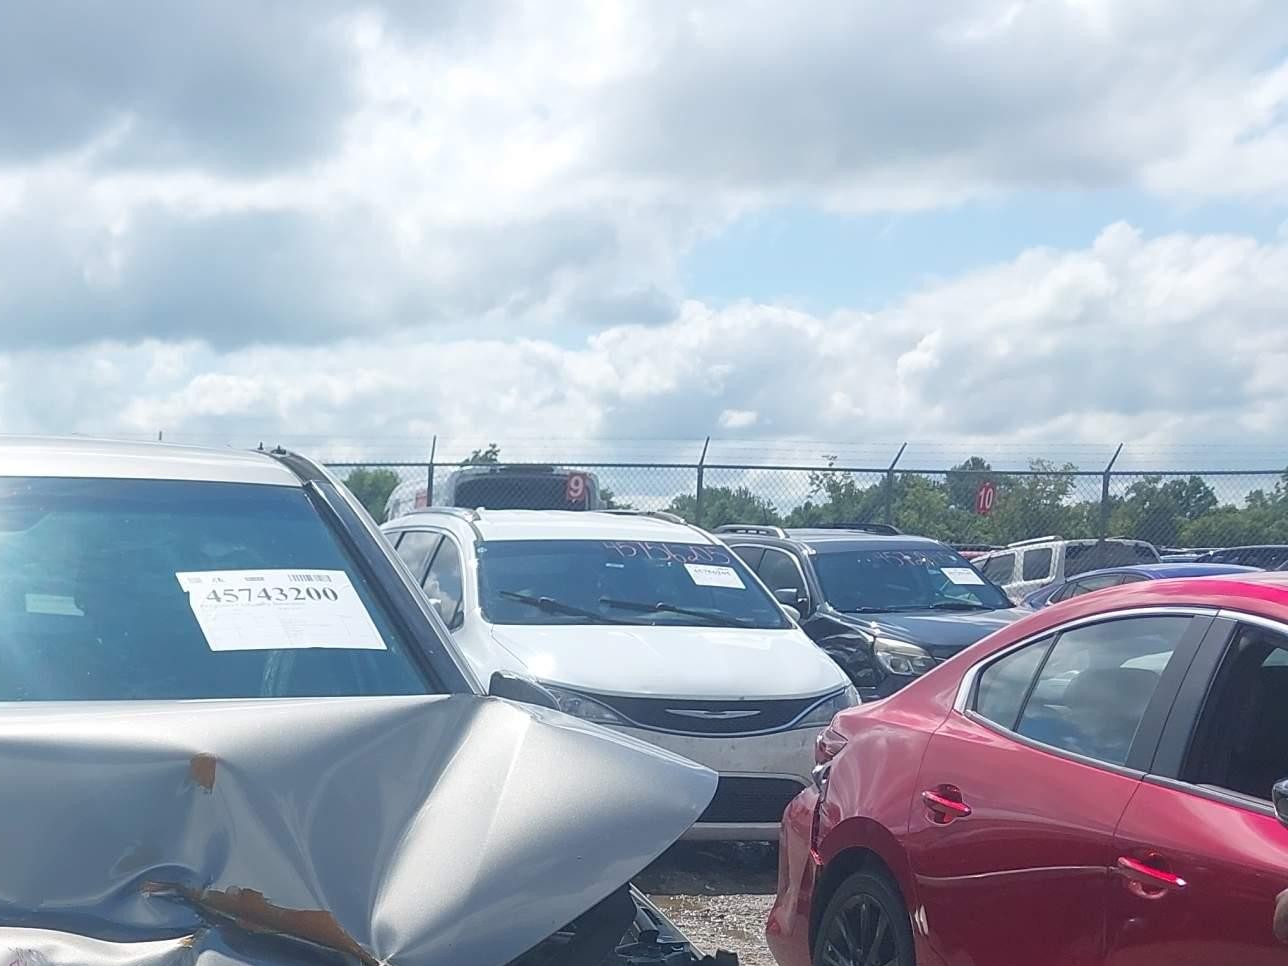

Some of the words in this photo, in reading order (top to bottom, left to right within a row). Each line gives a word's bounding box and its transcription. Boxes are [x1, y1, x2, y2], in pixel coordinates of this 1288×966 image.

[570, 475, 584, 497] 9
[979, 486, 993, 509] 10
[205, 586, 339, 603] 45743200
